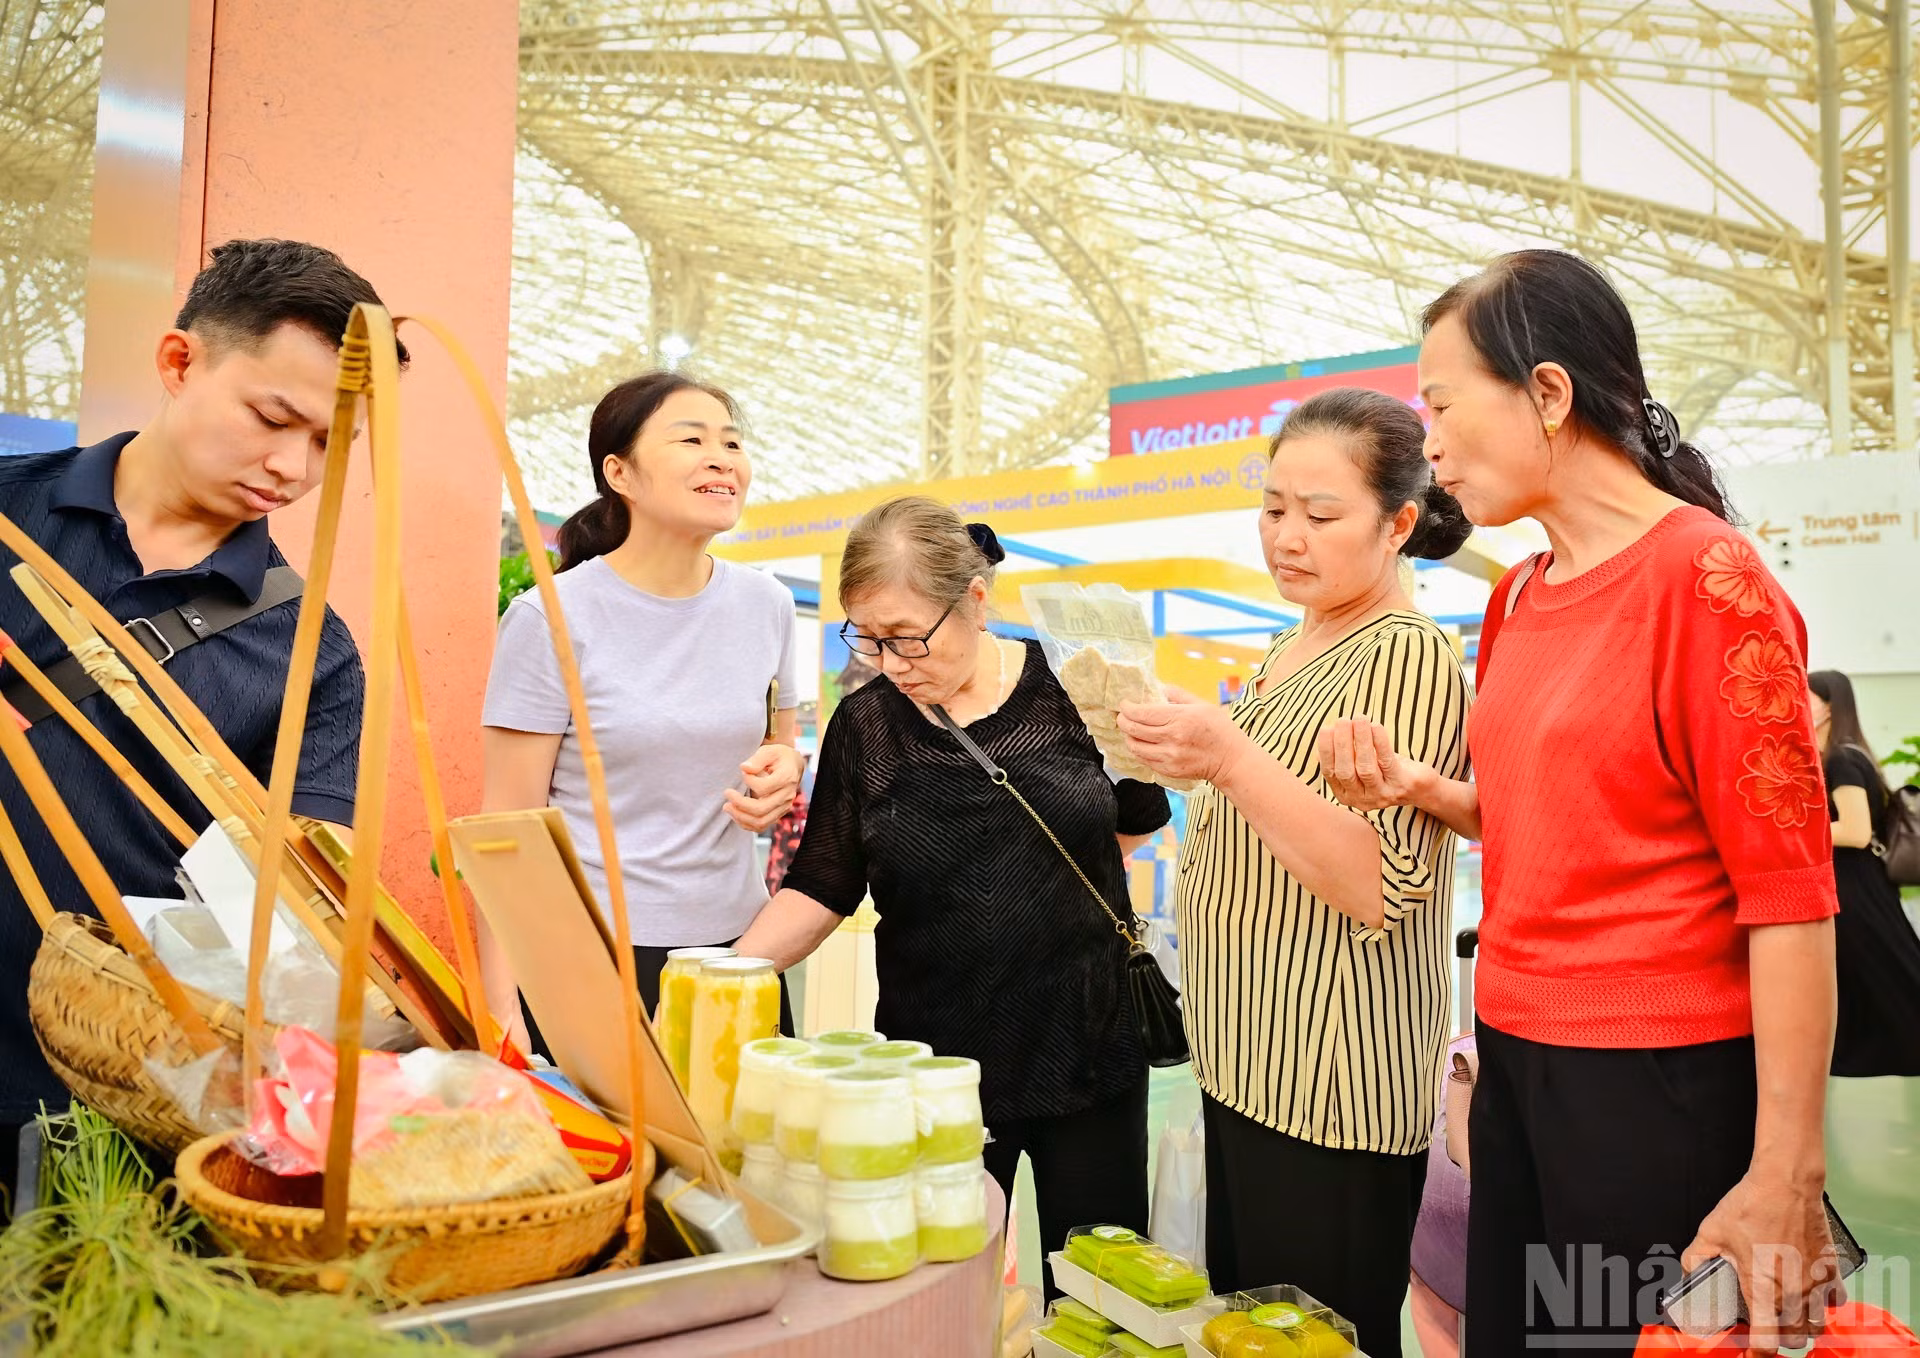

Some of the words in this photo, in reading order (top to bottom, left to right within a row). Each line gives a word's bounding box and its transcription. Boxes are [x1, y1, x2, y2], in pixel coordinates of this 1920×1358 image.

[1130, 416, 1253, 455] Vietlott
[993, 493, 1032, 511] NGHỆ
[1037, 492, 1070, 507] CAO
[1075, 484, 1129, 502] THÀNH
[1132, 475, 1167, 495] PHỐ
[1172, 471, 1195, 490] HÀ
[1200, 468, 1231, 488] NỘI
[1802, 515, 1857, 531] Trung
[1862, 512, 1901, 525] tâm
[1802, 535, 1847, 546] Center
[1852, 532, 1880, 544] Hall
